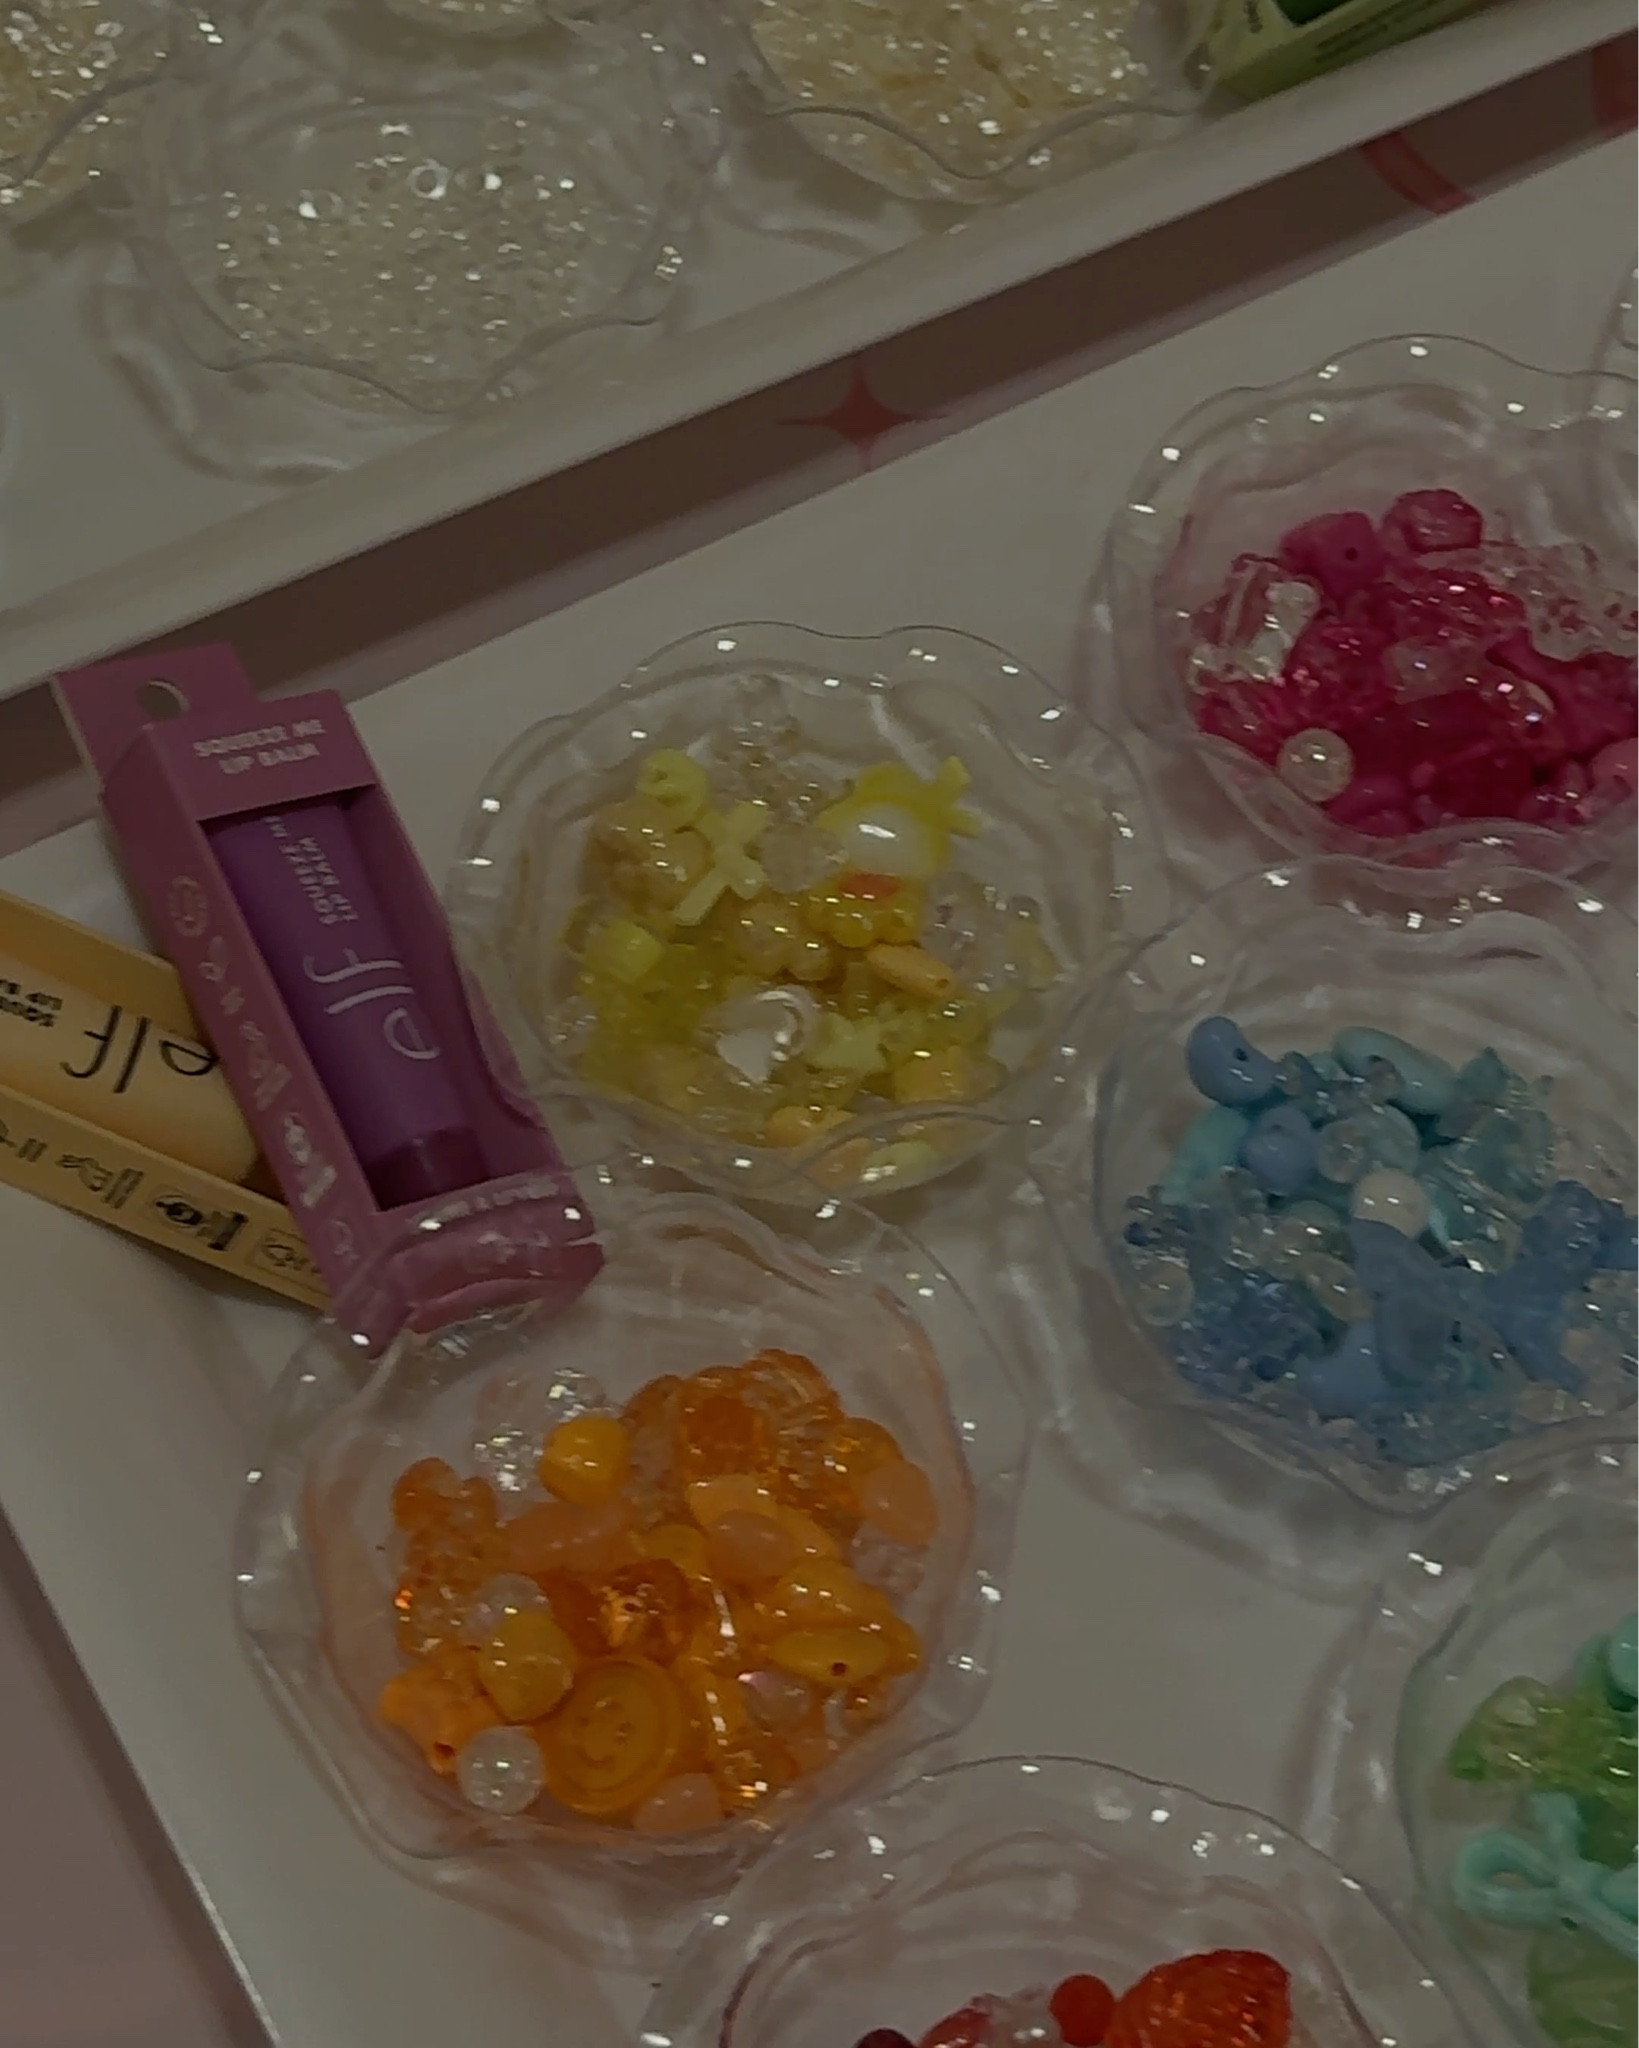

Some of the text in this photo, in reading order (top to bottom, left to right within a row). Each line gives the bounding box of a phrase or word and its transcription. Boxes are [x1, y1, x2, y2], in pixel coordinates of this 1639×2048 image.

[193, 719, 326, 757] SQUEEZE ME
[218, 743, 320, 774] LIP BALM
[280, 843, 338, 924] SQUEEZE
[298, 837, 359, 921] LIP BALM
[303, 948, 440, 1059] elf
[59, 1005, 220, 1093] elf
